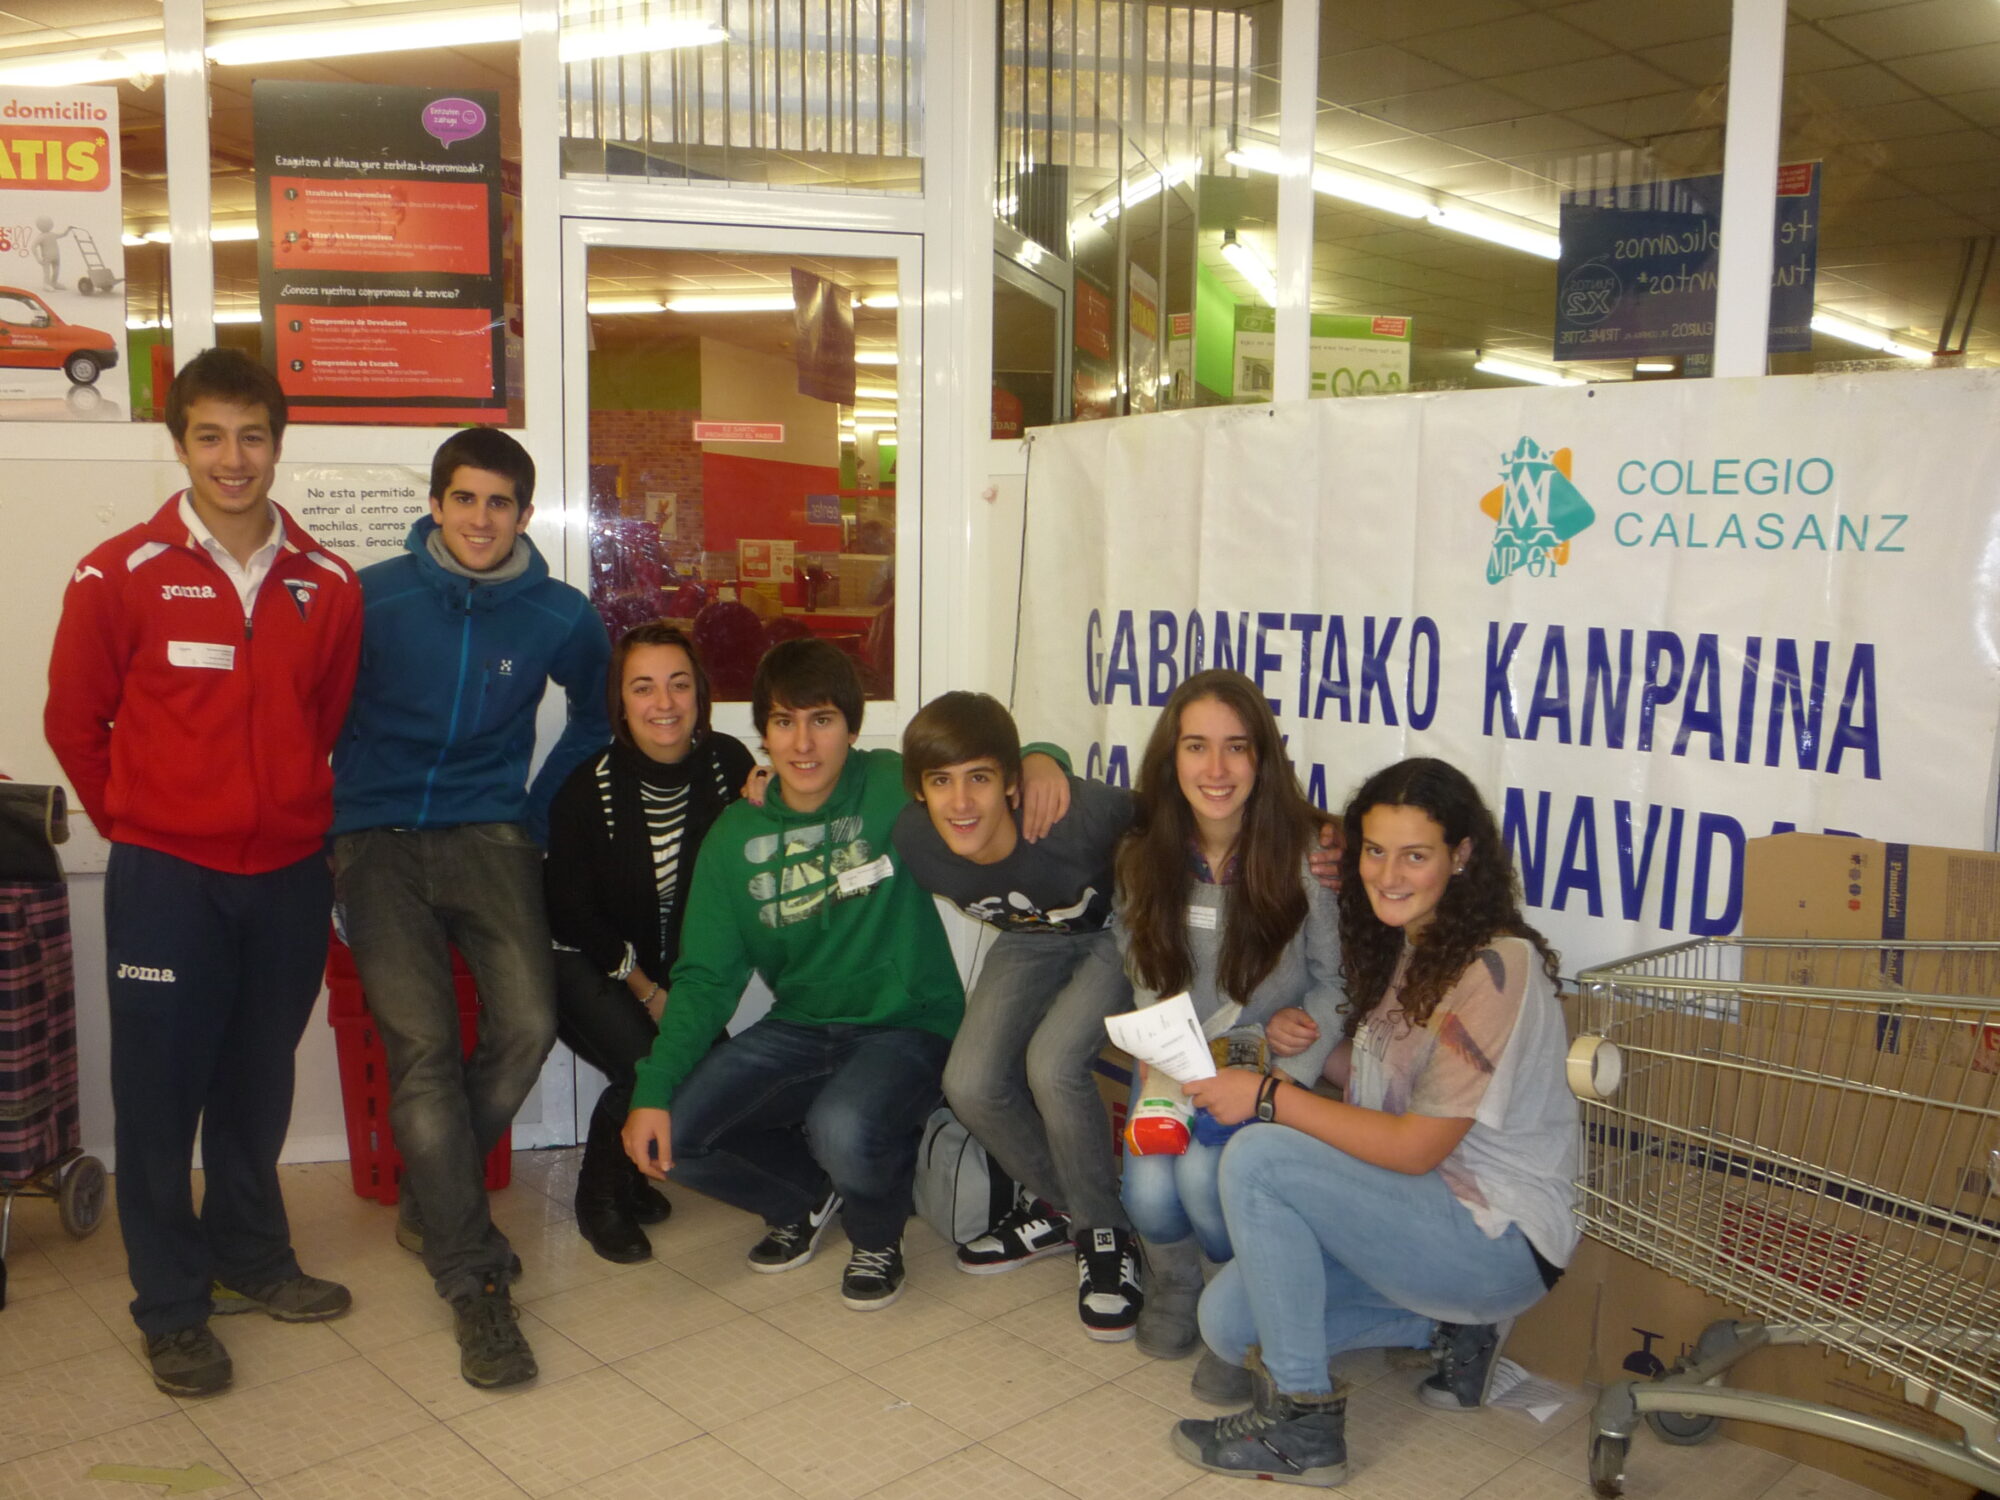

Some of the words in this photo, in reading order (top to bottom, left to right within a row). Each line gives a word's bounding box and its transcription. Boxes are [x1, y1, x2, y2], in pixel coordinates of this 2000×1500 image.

[3, 99, 108, 121] domicilio
[322, 157, 332, 168] al
[280, 284, 319, 297] ¿Conoces
[321, 285, 356, 297] nuestros
[358, 288, 410, 299] compromisos
[412, 287, 423, 298] de
[425, 289, 460, 299] servicio?
[1617, 457, 1835, 496] COLEGIO
[307, 489, 325, 498] No
[330, 489, 356, 498] esta
[360, 487, 416, 501] permitido
[302, 506, 341, 515] entrar
[345, 504, 356, 514] al
[360, 505, 399, 514] centro
[403, 506, 423, 514] con
[308, 521, 363, 533] mochilas,
[368, 522, 406, 531] carros
[1614, 512, 1909, 552] CALASANZ
[1086, 608, 1441, 731] GABONETAKO
[1482, 620, 1882, 781] KANPAINA
[1502, 786, 1866, 938] NAVID
[117, 963, 176, 983] Joma
